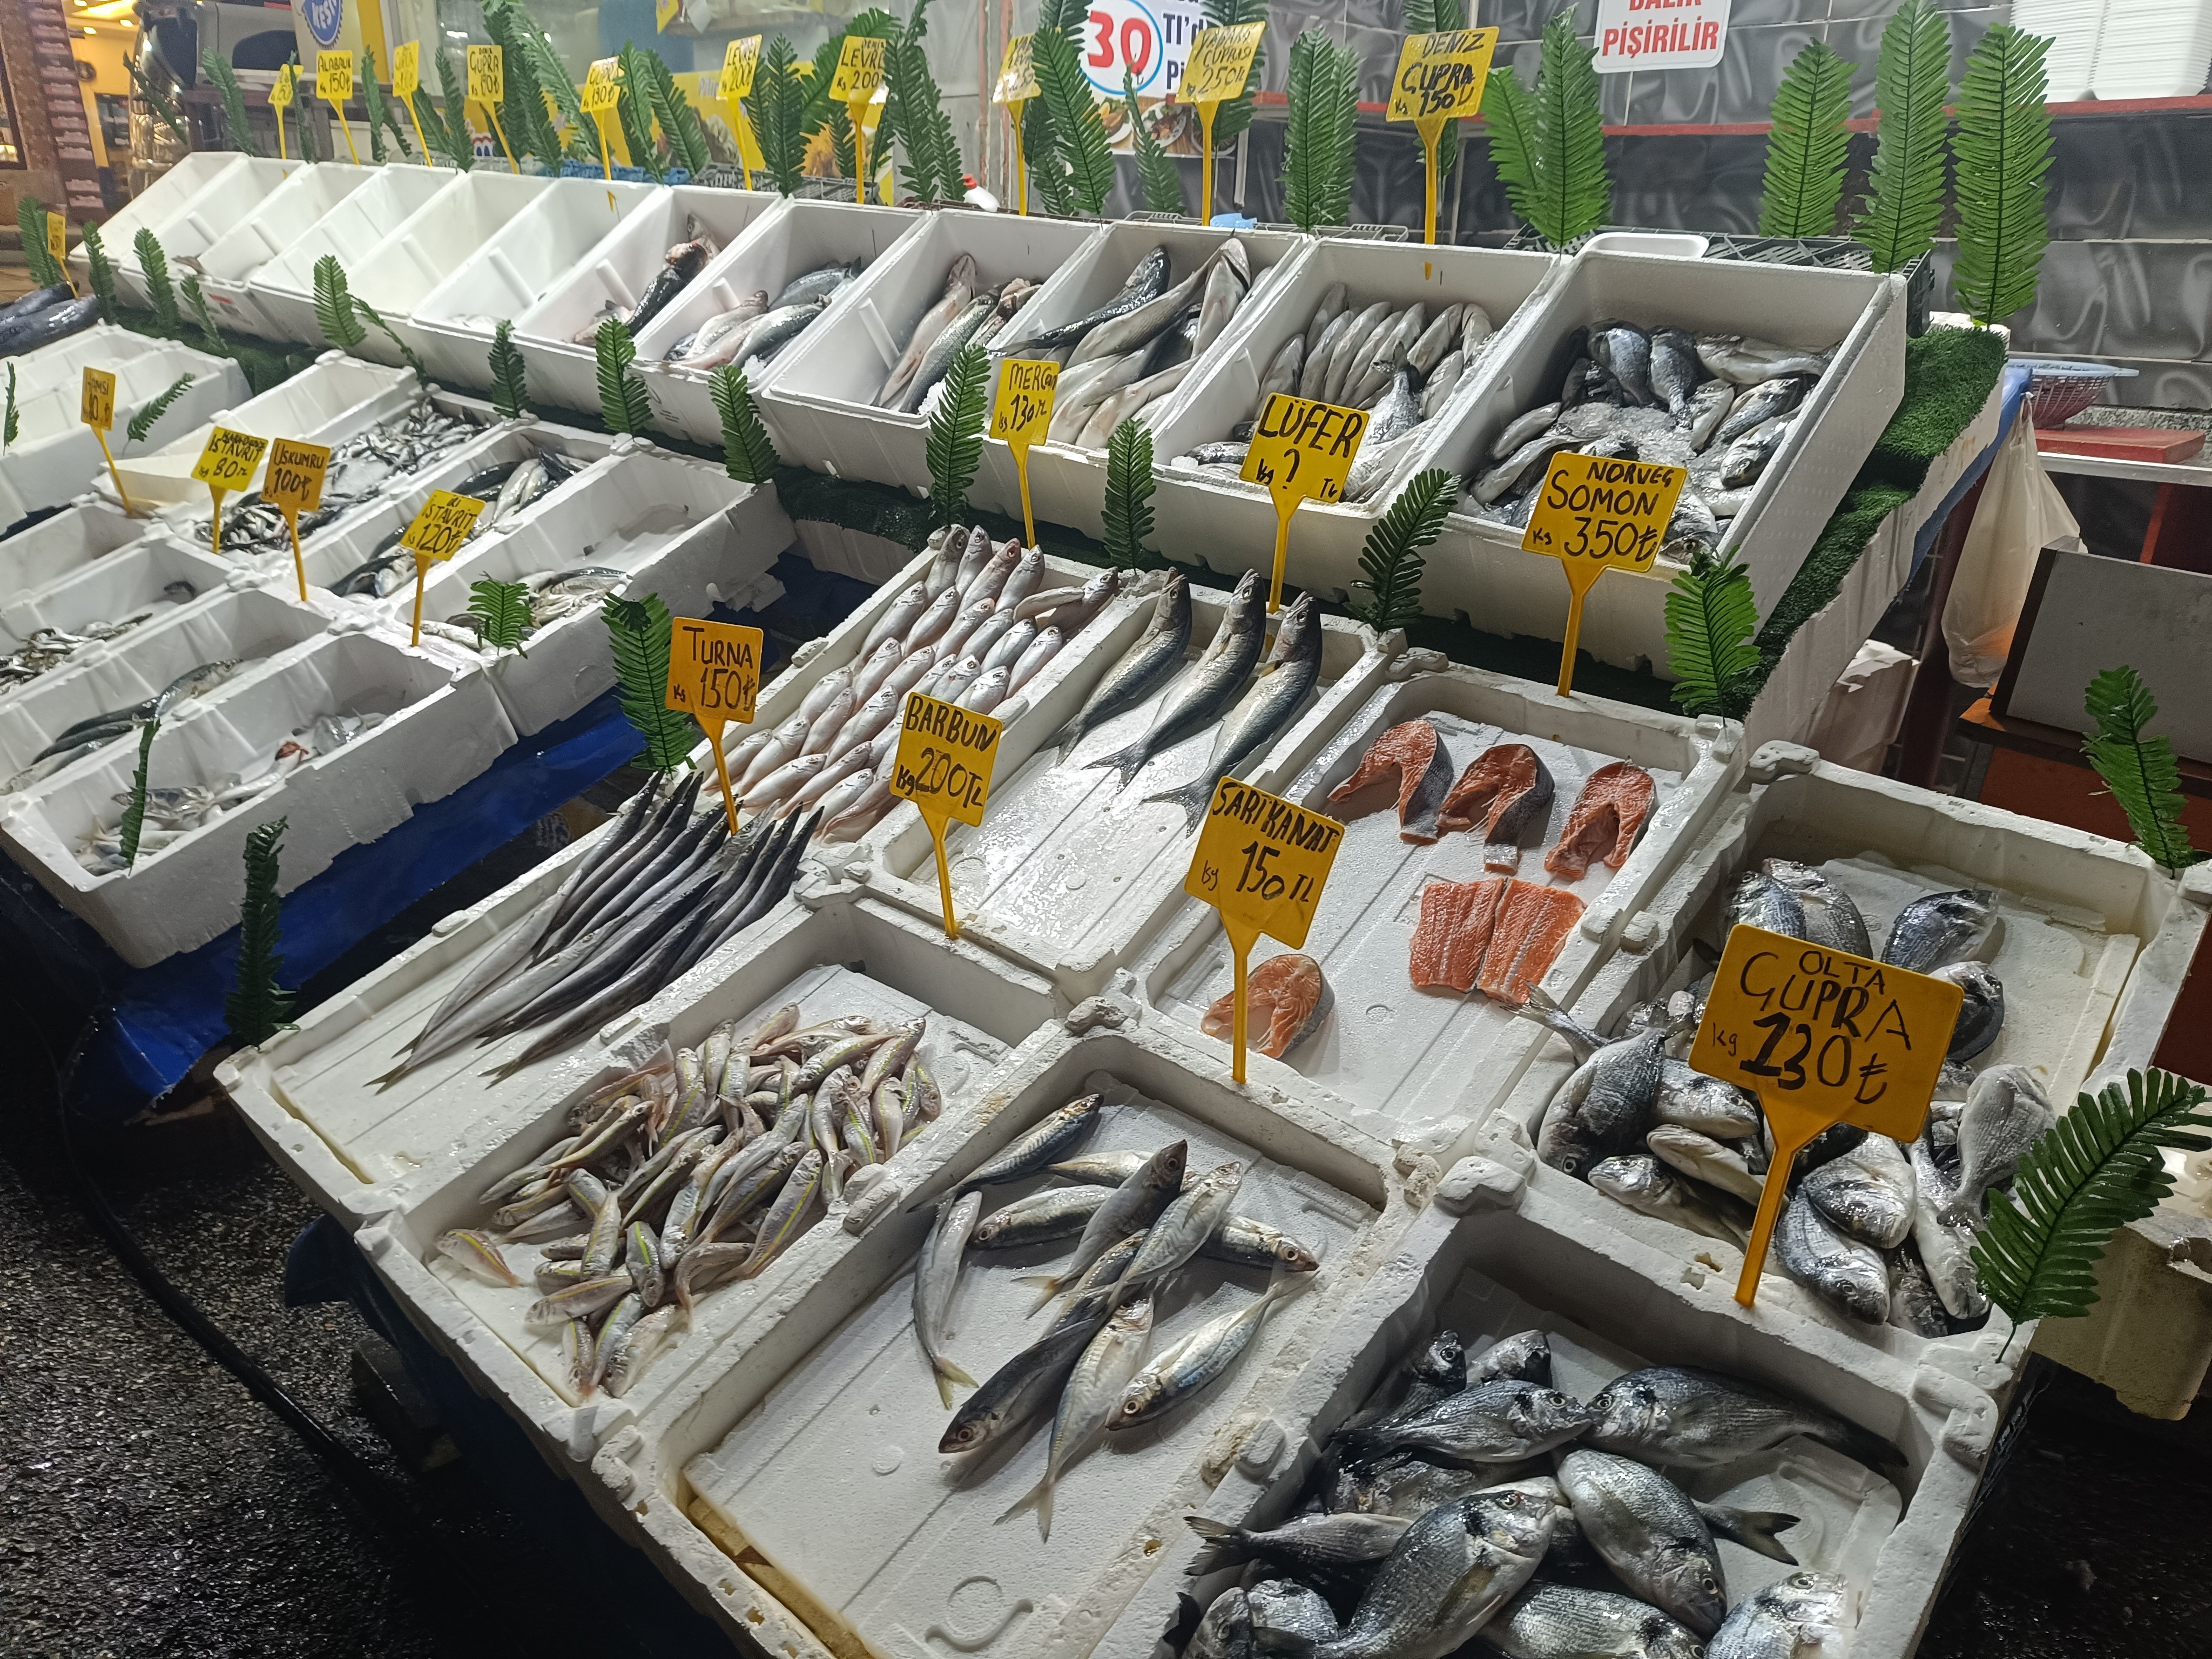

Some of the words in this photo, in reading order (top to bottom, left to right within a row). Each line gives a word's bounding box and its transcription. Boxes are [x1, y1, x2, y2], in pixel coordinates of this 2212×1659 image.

[1087, 10, 1151, 75] 30
[1602, 16, 1719, 59] PİŞİRİLİR
[1257, 395, 1363, 458] LÜFER
[274, 443, 325, 469] USKUMRU
[1547, 469, 1660, 517] SOMON
[682, 626, 753, 670] TURNA
[905, 695, 997, 752] BARBUN
[1798, 950, 1886, 995] OLTA
